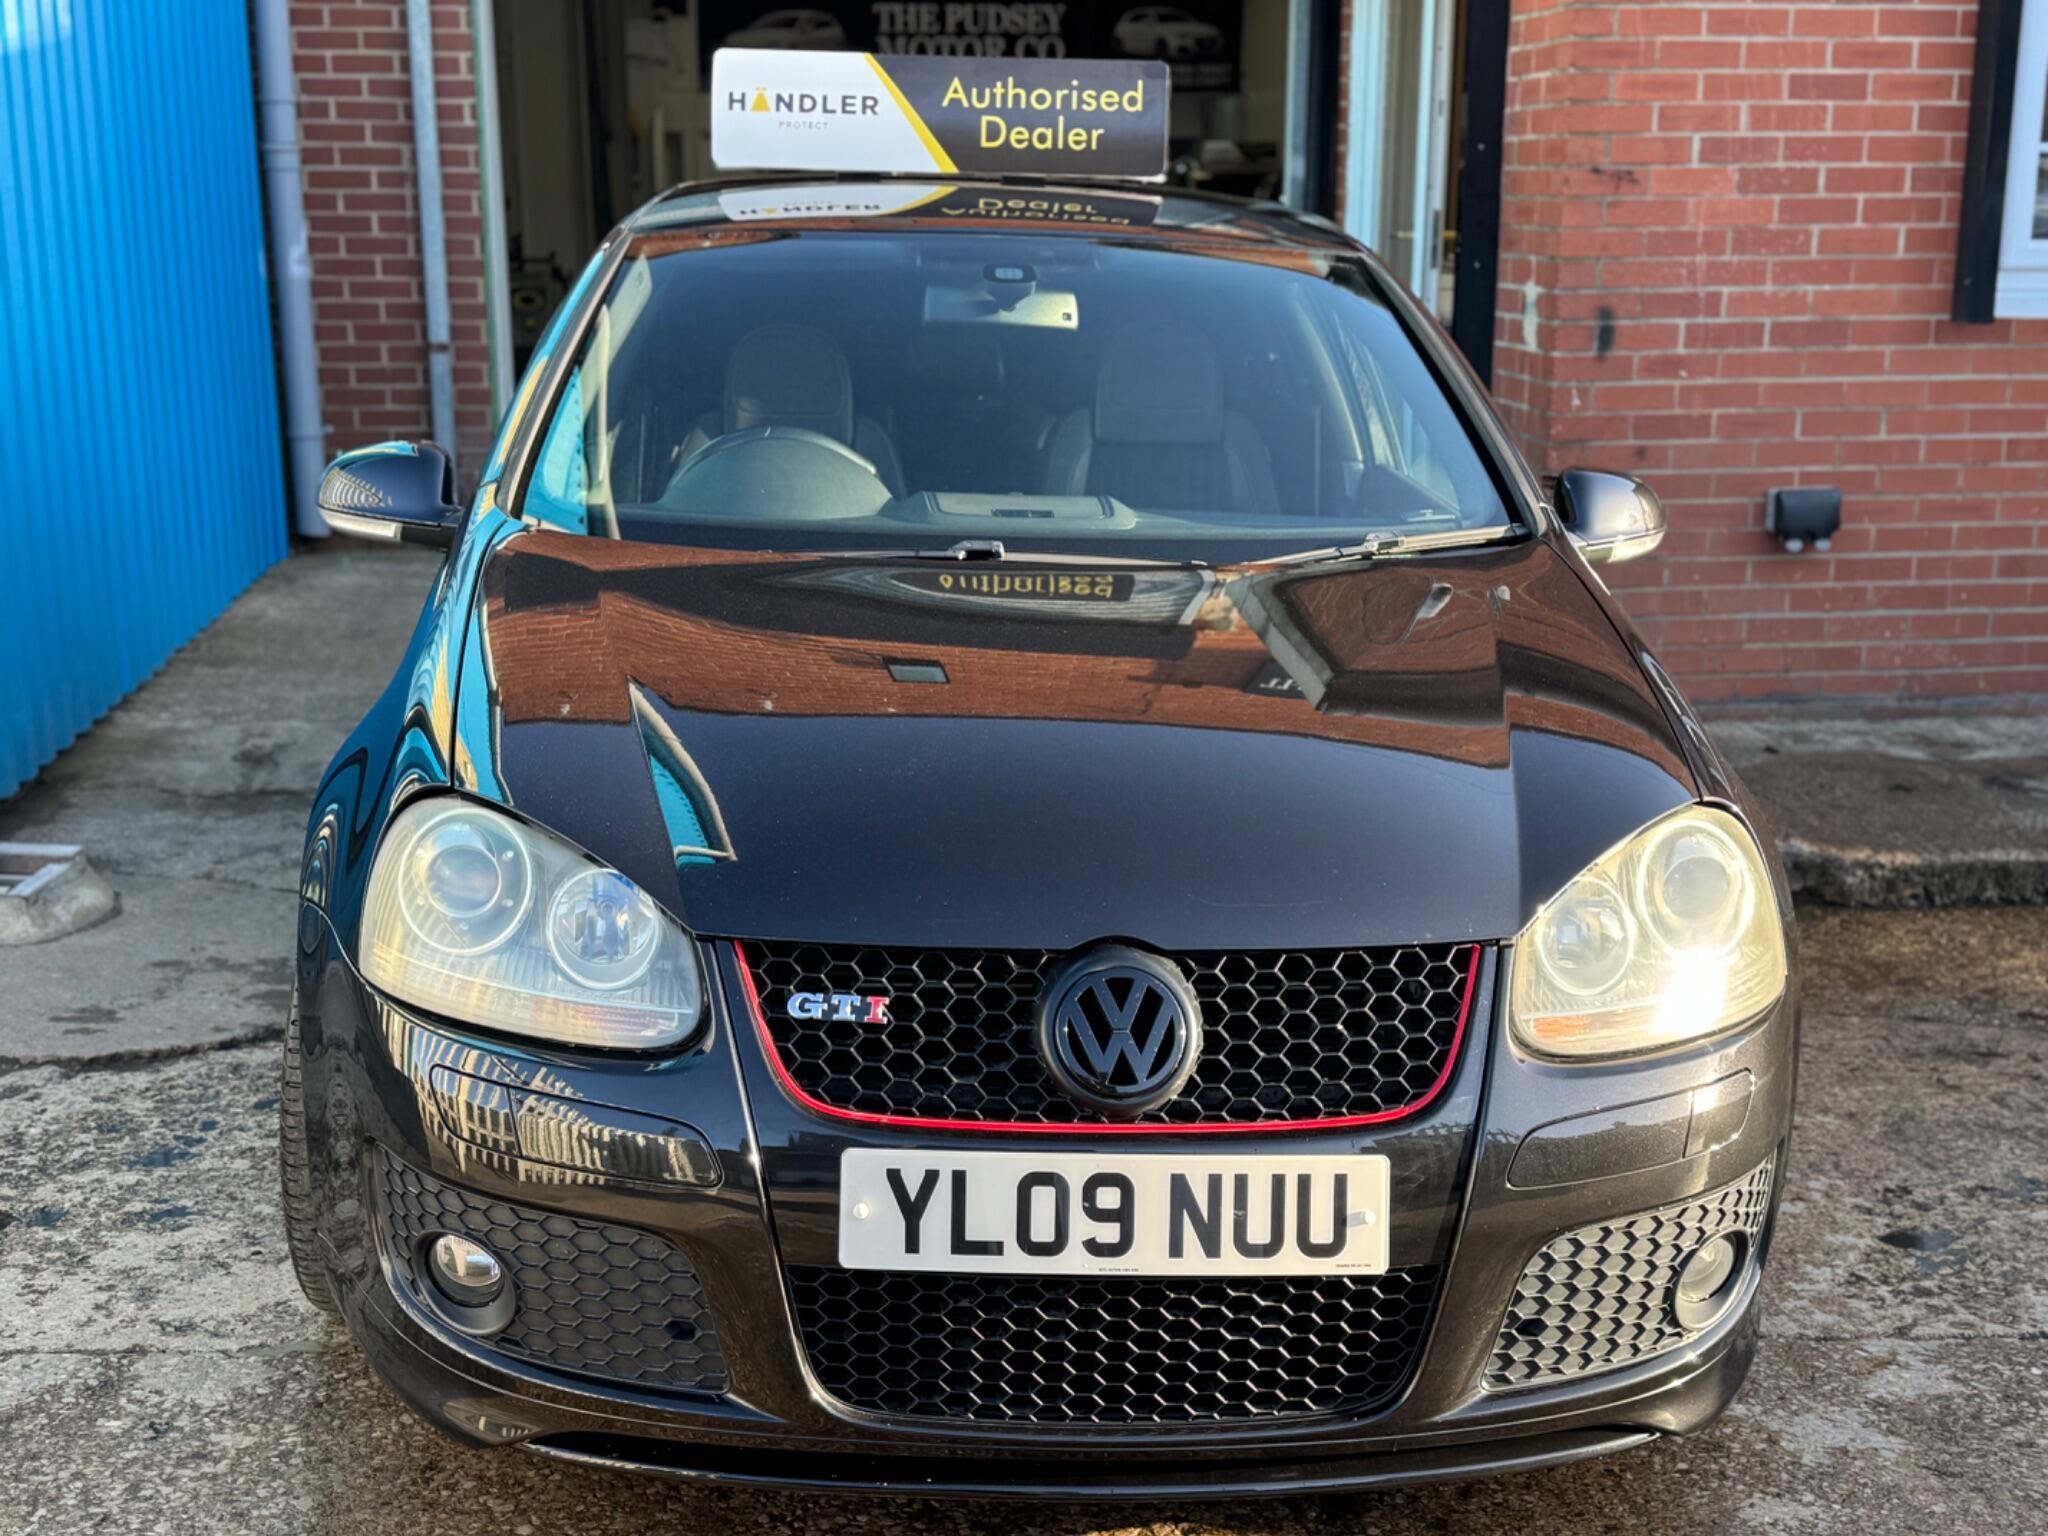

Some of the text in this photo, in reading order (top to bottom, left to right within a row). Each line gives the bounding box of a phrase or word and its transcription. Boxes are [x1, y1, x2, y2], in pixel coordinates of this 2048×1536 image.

[871, 2, 1067, 34] THE PUDSEY
[941, 76, 1144, 113] Authorised
[778, 120, 829, 130] PROTECT
[979, 114, 1105, 151] Dealer
[787, 992, 890, 1025] GTI
[1056, 966, 1187, 1097] VW
[886, 1168, 1348, 1259] YL09 NUU
